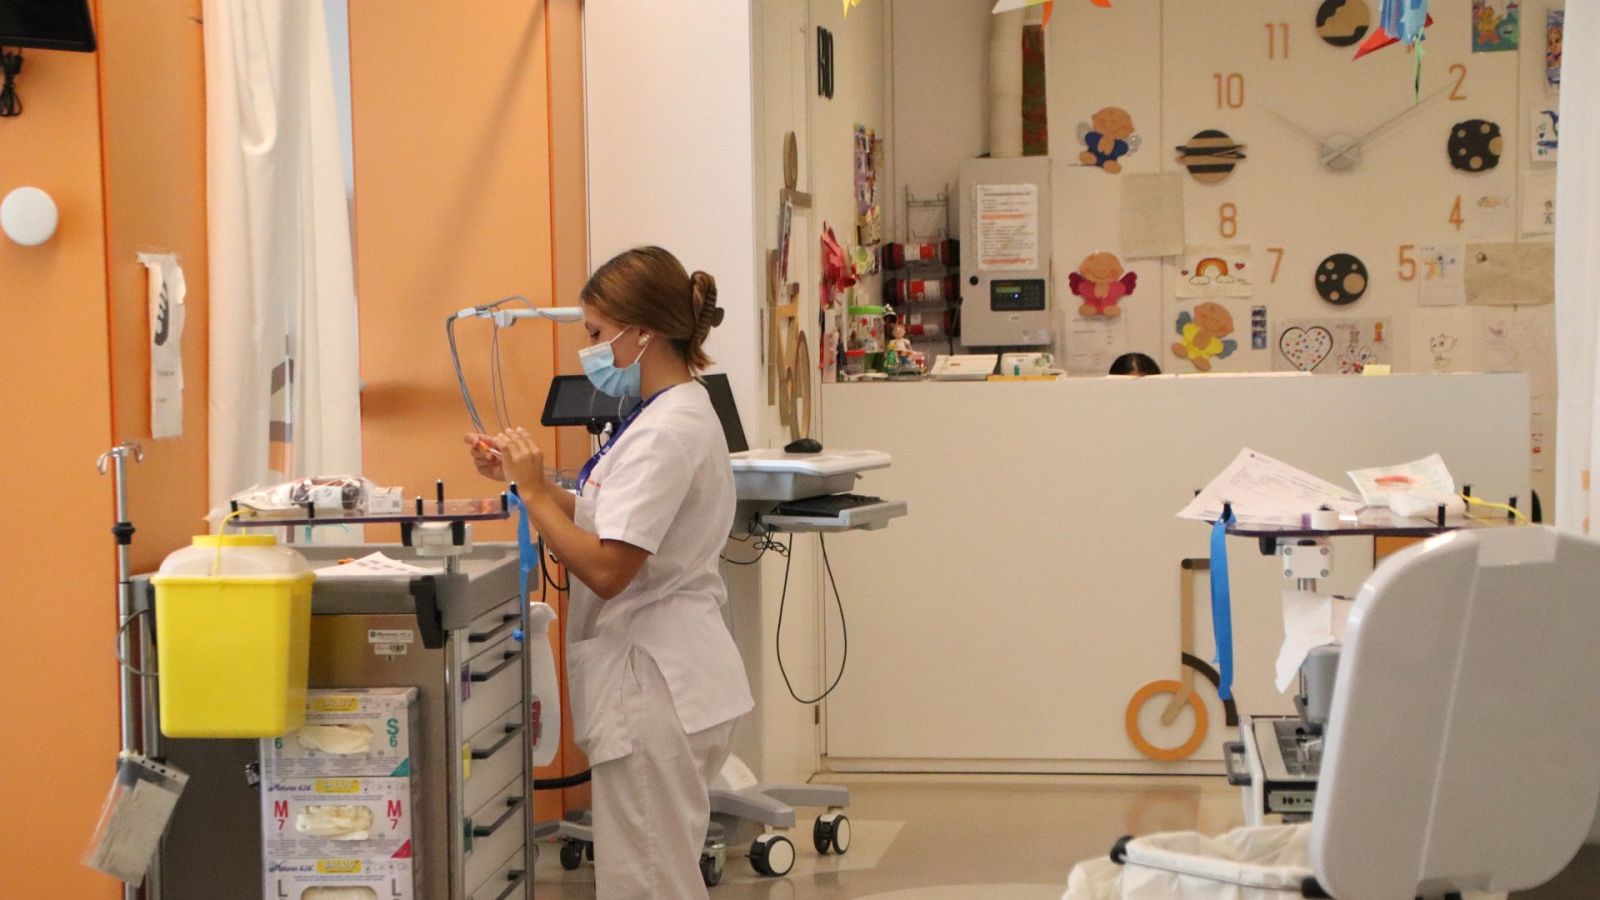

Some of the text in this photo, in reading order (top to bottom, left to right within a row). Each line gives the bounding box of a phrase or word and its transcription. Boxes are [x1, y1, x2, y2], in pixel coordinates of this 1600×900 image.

[1264, 22, 1290, 60] 11
[1212, 73, 1245, 109] 10
[1448, 63, 1467, 101] 2
[1219, 202, 1237, 239] 8
[1448, 195, 1465, 231] 4
[1266, 247, 1284, 284] 7
[1398, 244, 1416, 282] 5
[387, 718, 399, 735] S
[274, 737, 283, 749] 6
[388, 735, 398, 748] 6
[274, 800, 289, 818] M
[386, 800, 402, 818] M
[277, 819, 284, 830] 7
[389, 819, 398, 830] 7
[278, 880, 288, 897] L
[391, 878, 402, 897] L
